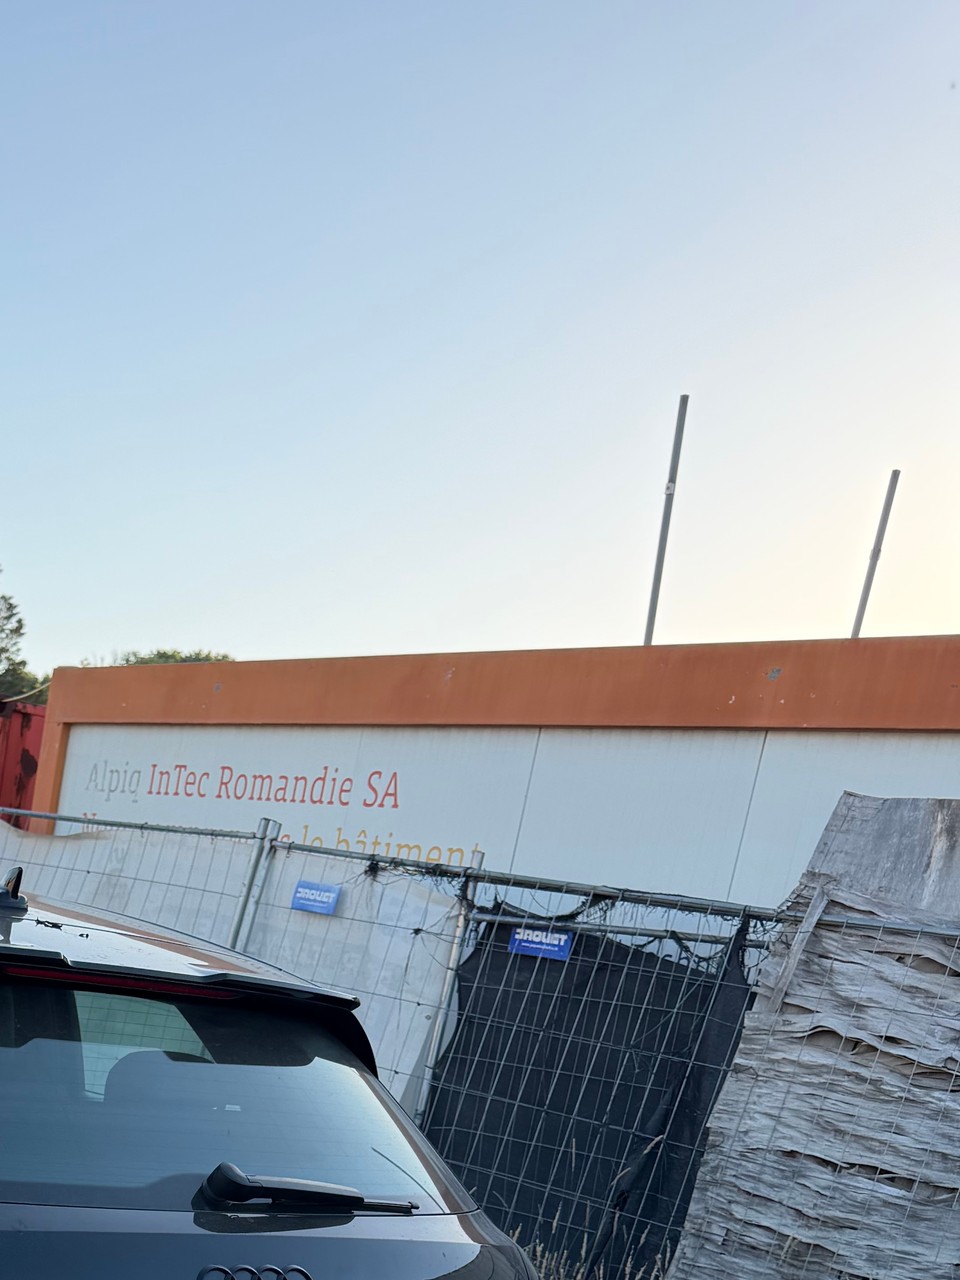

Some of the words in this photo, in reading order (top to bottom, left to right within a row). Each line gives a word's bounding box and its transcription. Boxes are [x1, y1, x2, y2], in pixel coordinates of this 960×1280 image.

[147, 764, 210, 798] InTec
[215, 765, 353, 806] Romandie
[362, 770, 400, 809] SA
[337, 827, 480, 865] bâtimen
